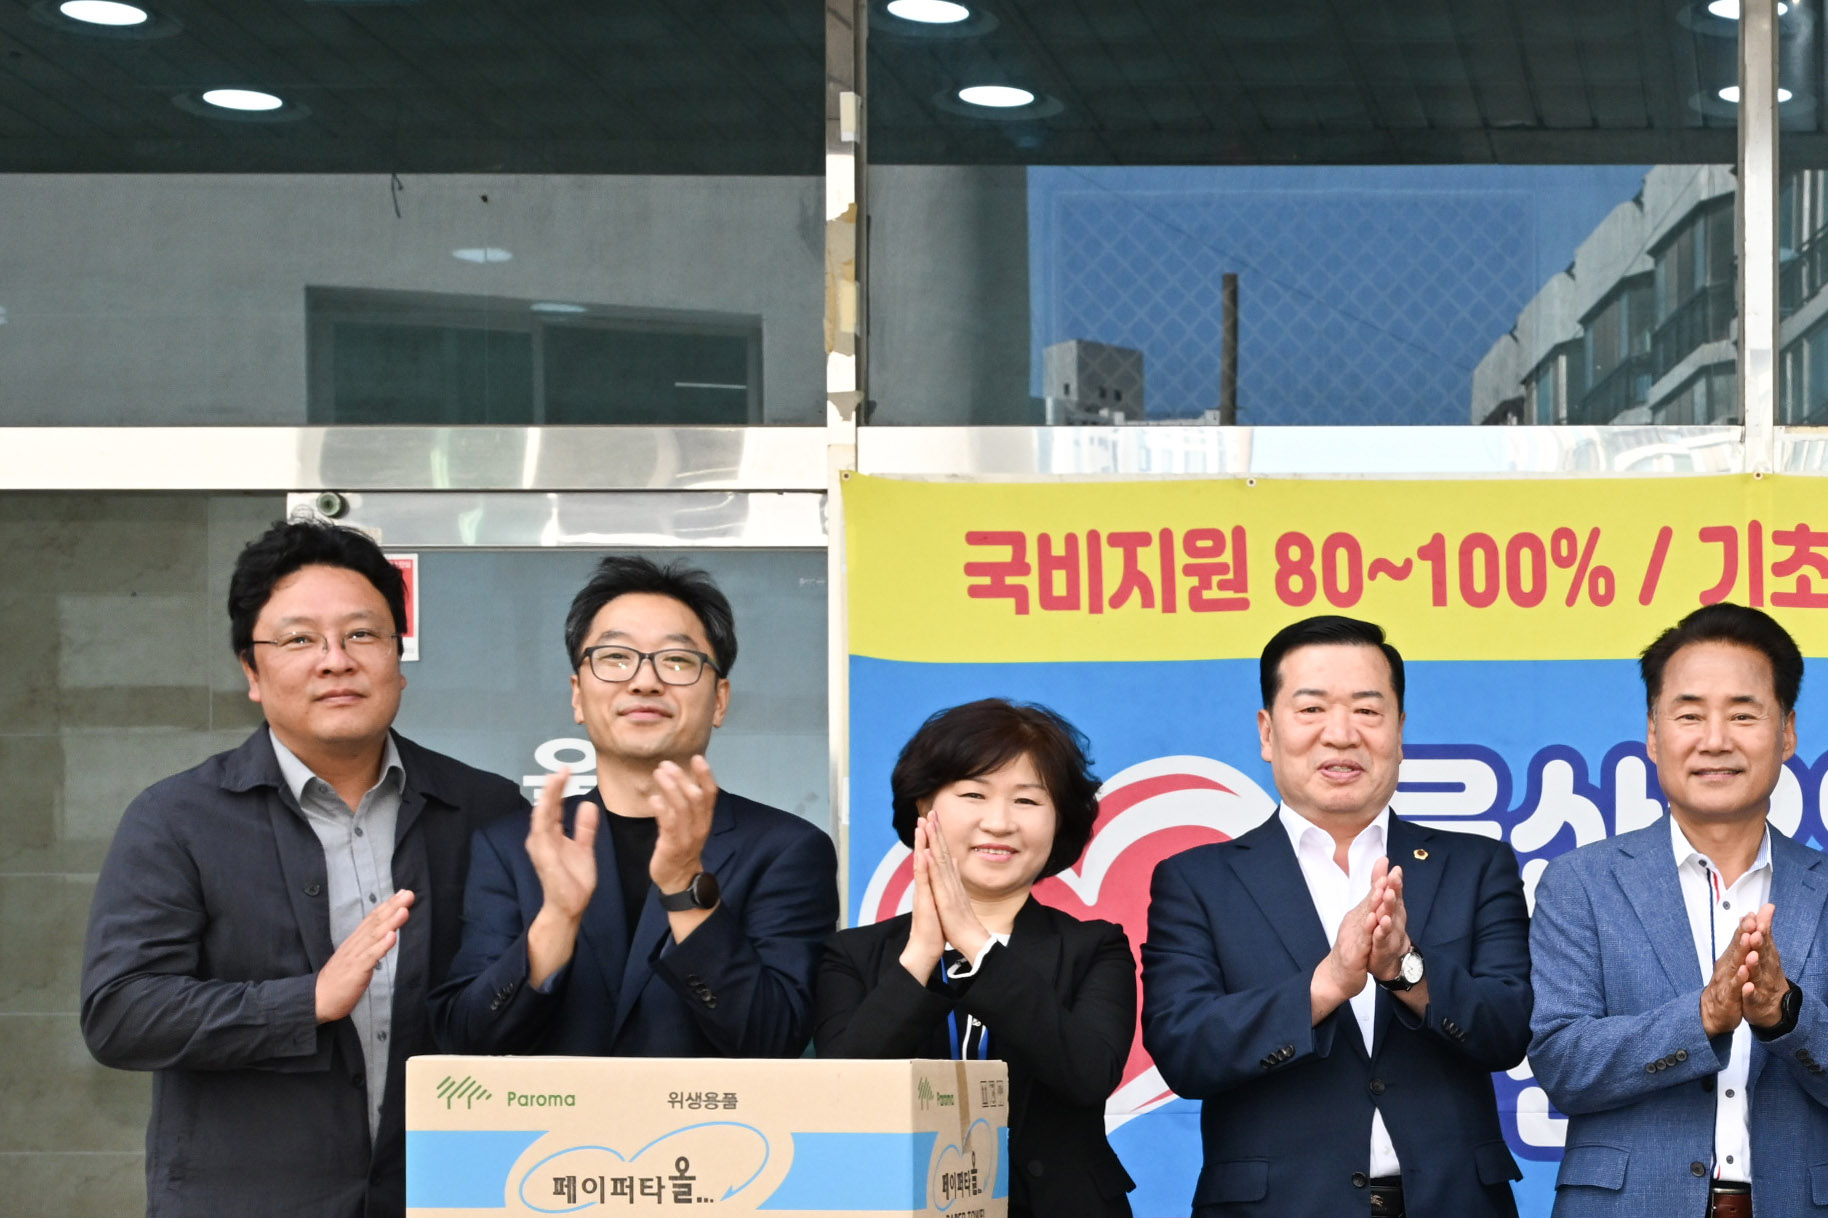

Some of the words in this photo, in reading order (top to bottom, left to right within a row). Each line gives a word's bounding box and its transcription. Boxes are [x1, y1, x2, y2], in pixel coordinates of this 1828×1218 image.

[964, 525, 1250, 615] 국비지원
[1274, 526, 1616, 608] 80~100%
[1638, 526, 1674, 606] /
[507, 1091, 576, 1107] Paroma
[667, 1091, 738, 1110] 위생용품
